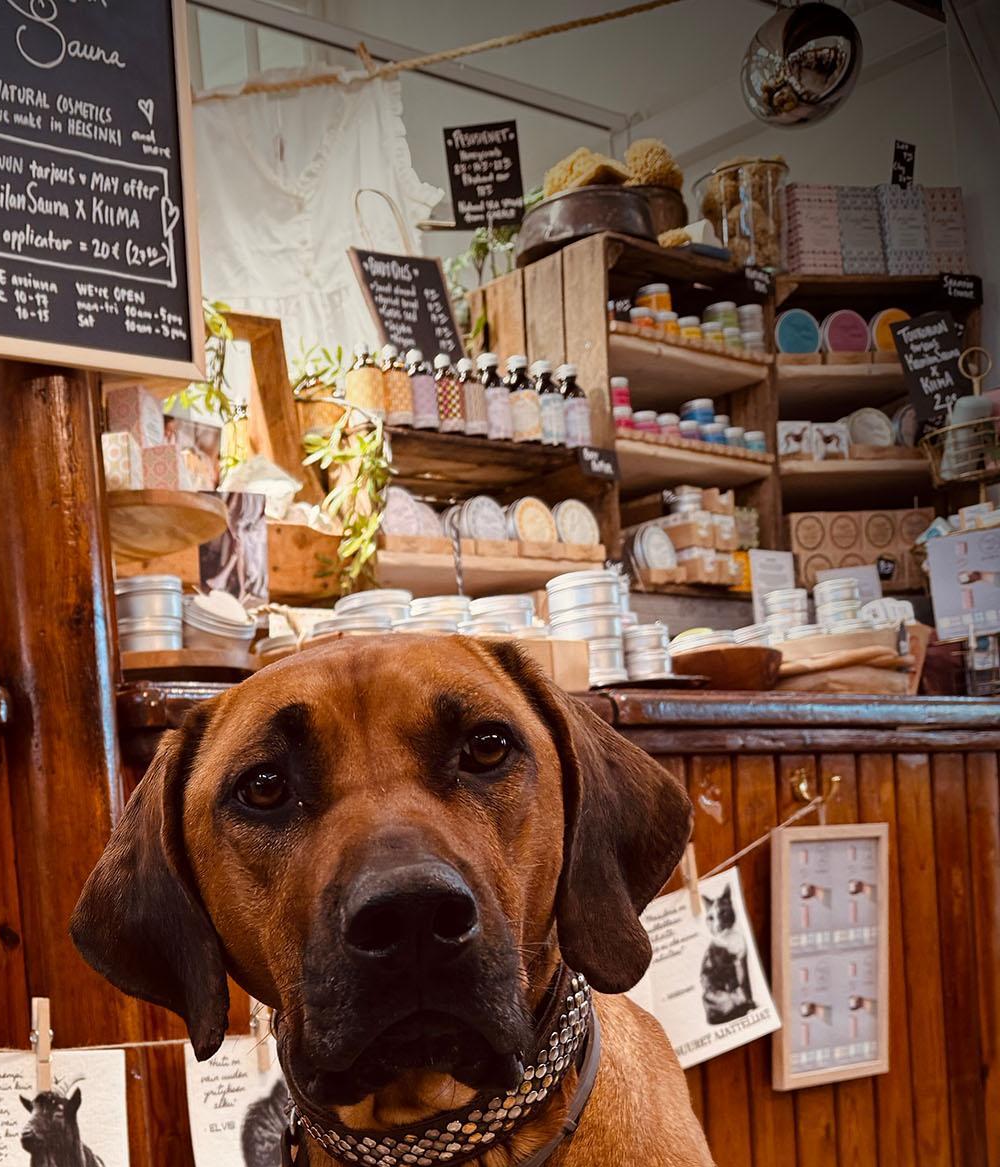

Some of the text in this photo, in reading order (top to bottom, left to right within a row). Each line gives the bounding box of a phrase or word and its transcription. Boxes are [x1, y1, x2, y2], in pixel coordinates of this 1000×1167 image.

[12, 0, 126, 69] Sauna
[57, 94, 112, 124] COSMETICS
[14, 112, 42, 129] make
[51, 116, 62, 134] in
[69, 118, 121, 146] HELSINKI
[132, 130, 156, 143] and
[142, 144, 171, 158] more
[30, 160, 75, 185] tarjous
[91, 172, 118, 195] MAY
[123, 178, 159, 200] offer
[93, 197, 139, 229] KIIMA
[114, 286, 145, 304] OPEN
